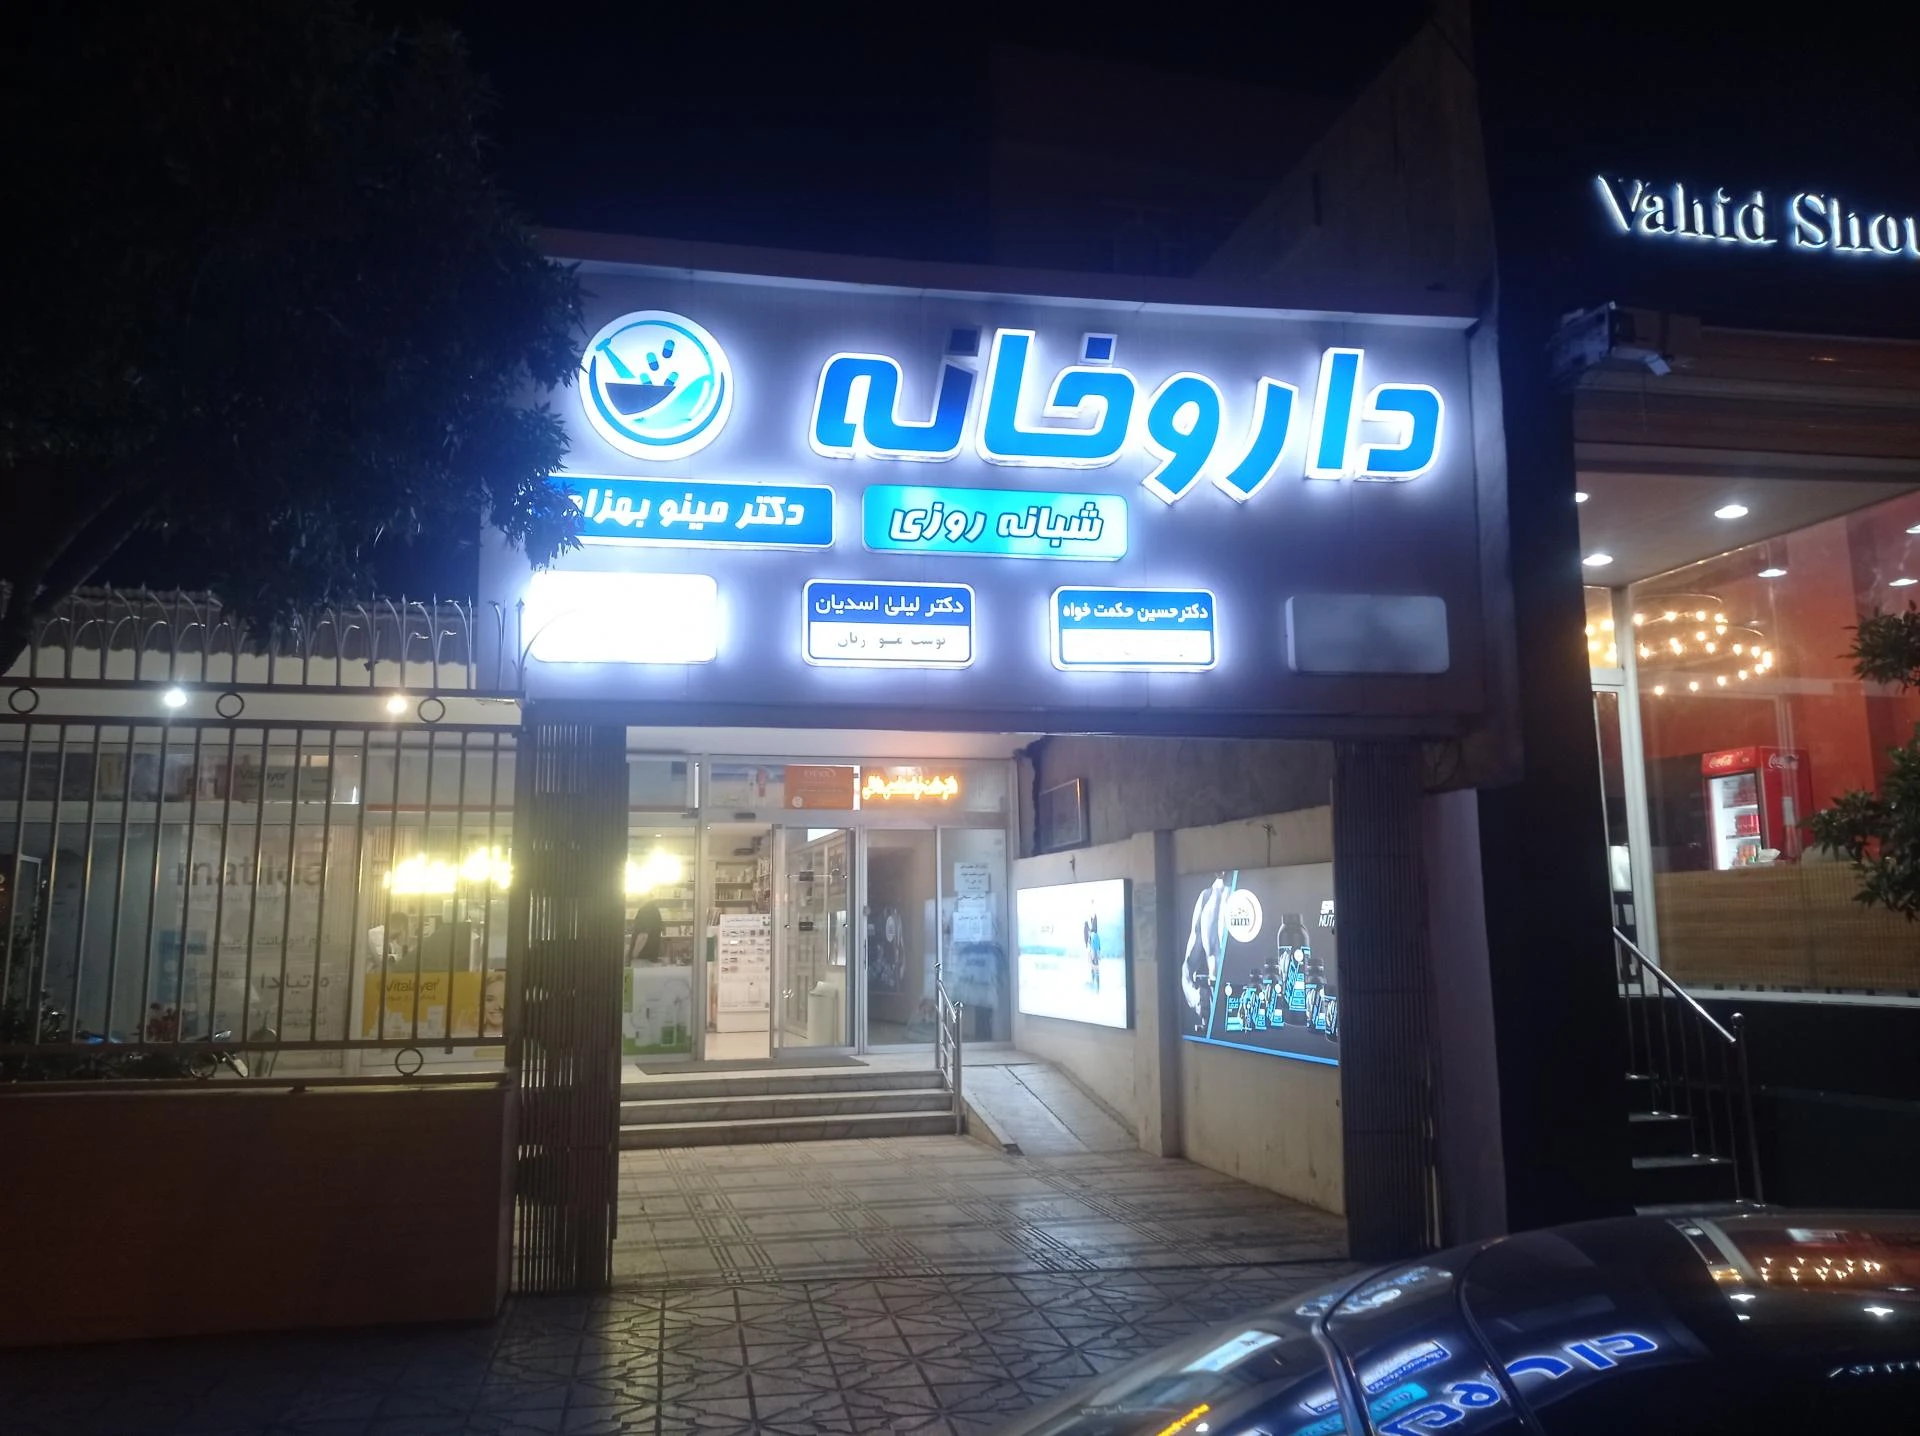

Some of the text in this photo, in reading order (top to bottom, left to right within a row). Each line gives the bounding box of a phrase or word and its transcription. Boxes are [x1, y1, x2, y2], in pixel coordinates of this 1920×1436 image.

[1596, 173, 1778, 245] Vahid
[807, 326, 1446, 504] داروخانه
[658, 492, 729, 531] مینو
[734, 494, 805, 530] دکتر
[888, 500, 1105, 548] شبانه روزی
[815, 594, 879, 615] اسدیان
[924, 596, 965, 618] دکتر
[1062, 601, 1209, 624] دکتر حسین حکمت خواه
[385, 977, 439, 994] Vitalyer
